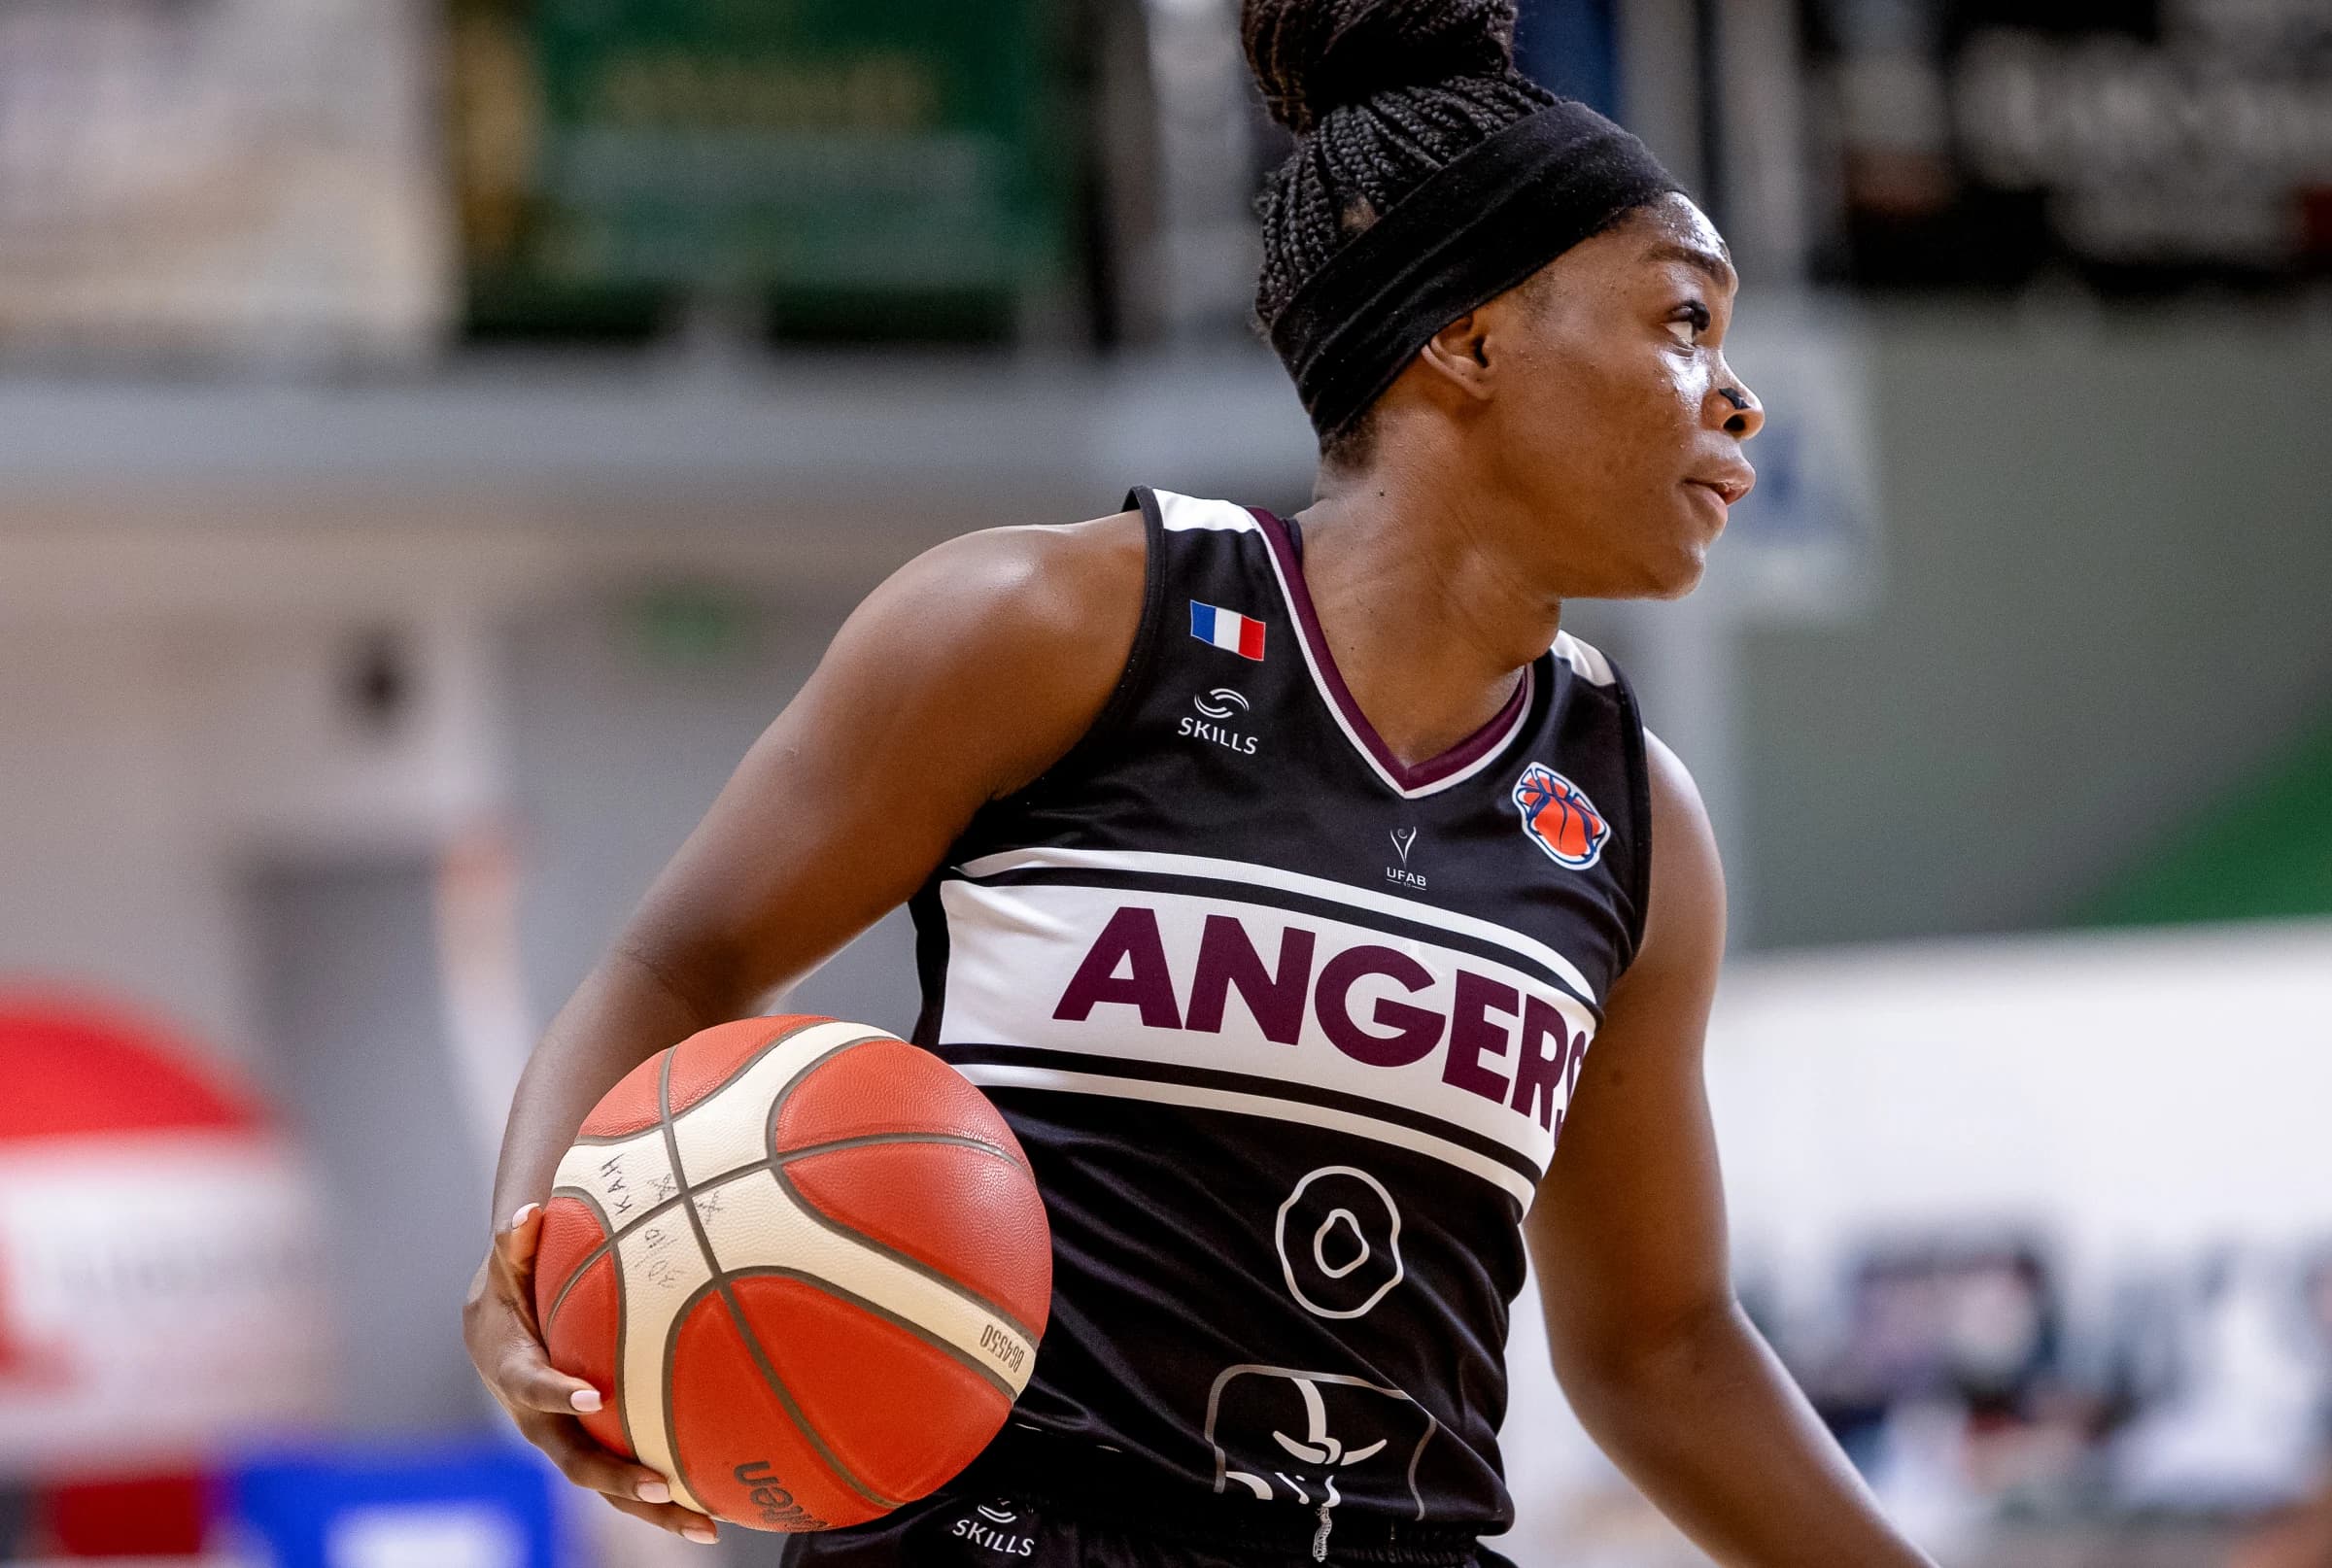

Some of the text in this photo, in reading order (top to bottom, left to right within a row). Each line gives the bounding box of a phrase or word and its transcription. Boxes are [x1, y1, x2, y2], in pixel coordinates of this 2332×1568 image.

[1178, 717, 1258, 755] SKILLS
[1387, 867, 1426, 886] UFAB
[979, 1324, 1025, 1374] BG4550
[952, 1519, 1035, 1556] SKILLS
